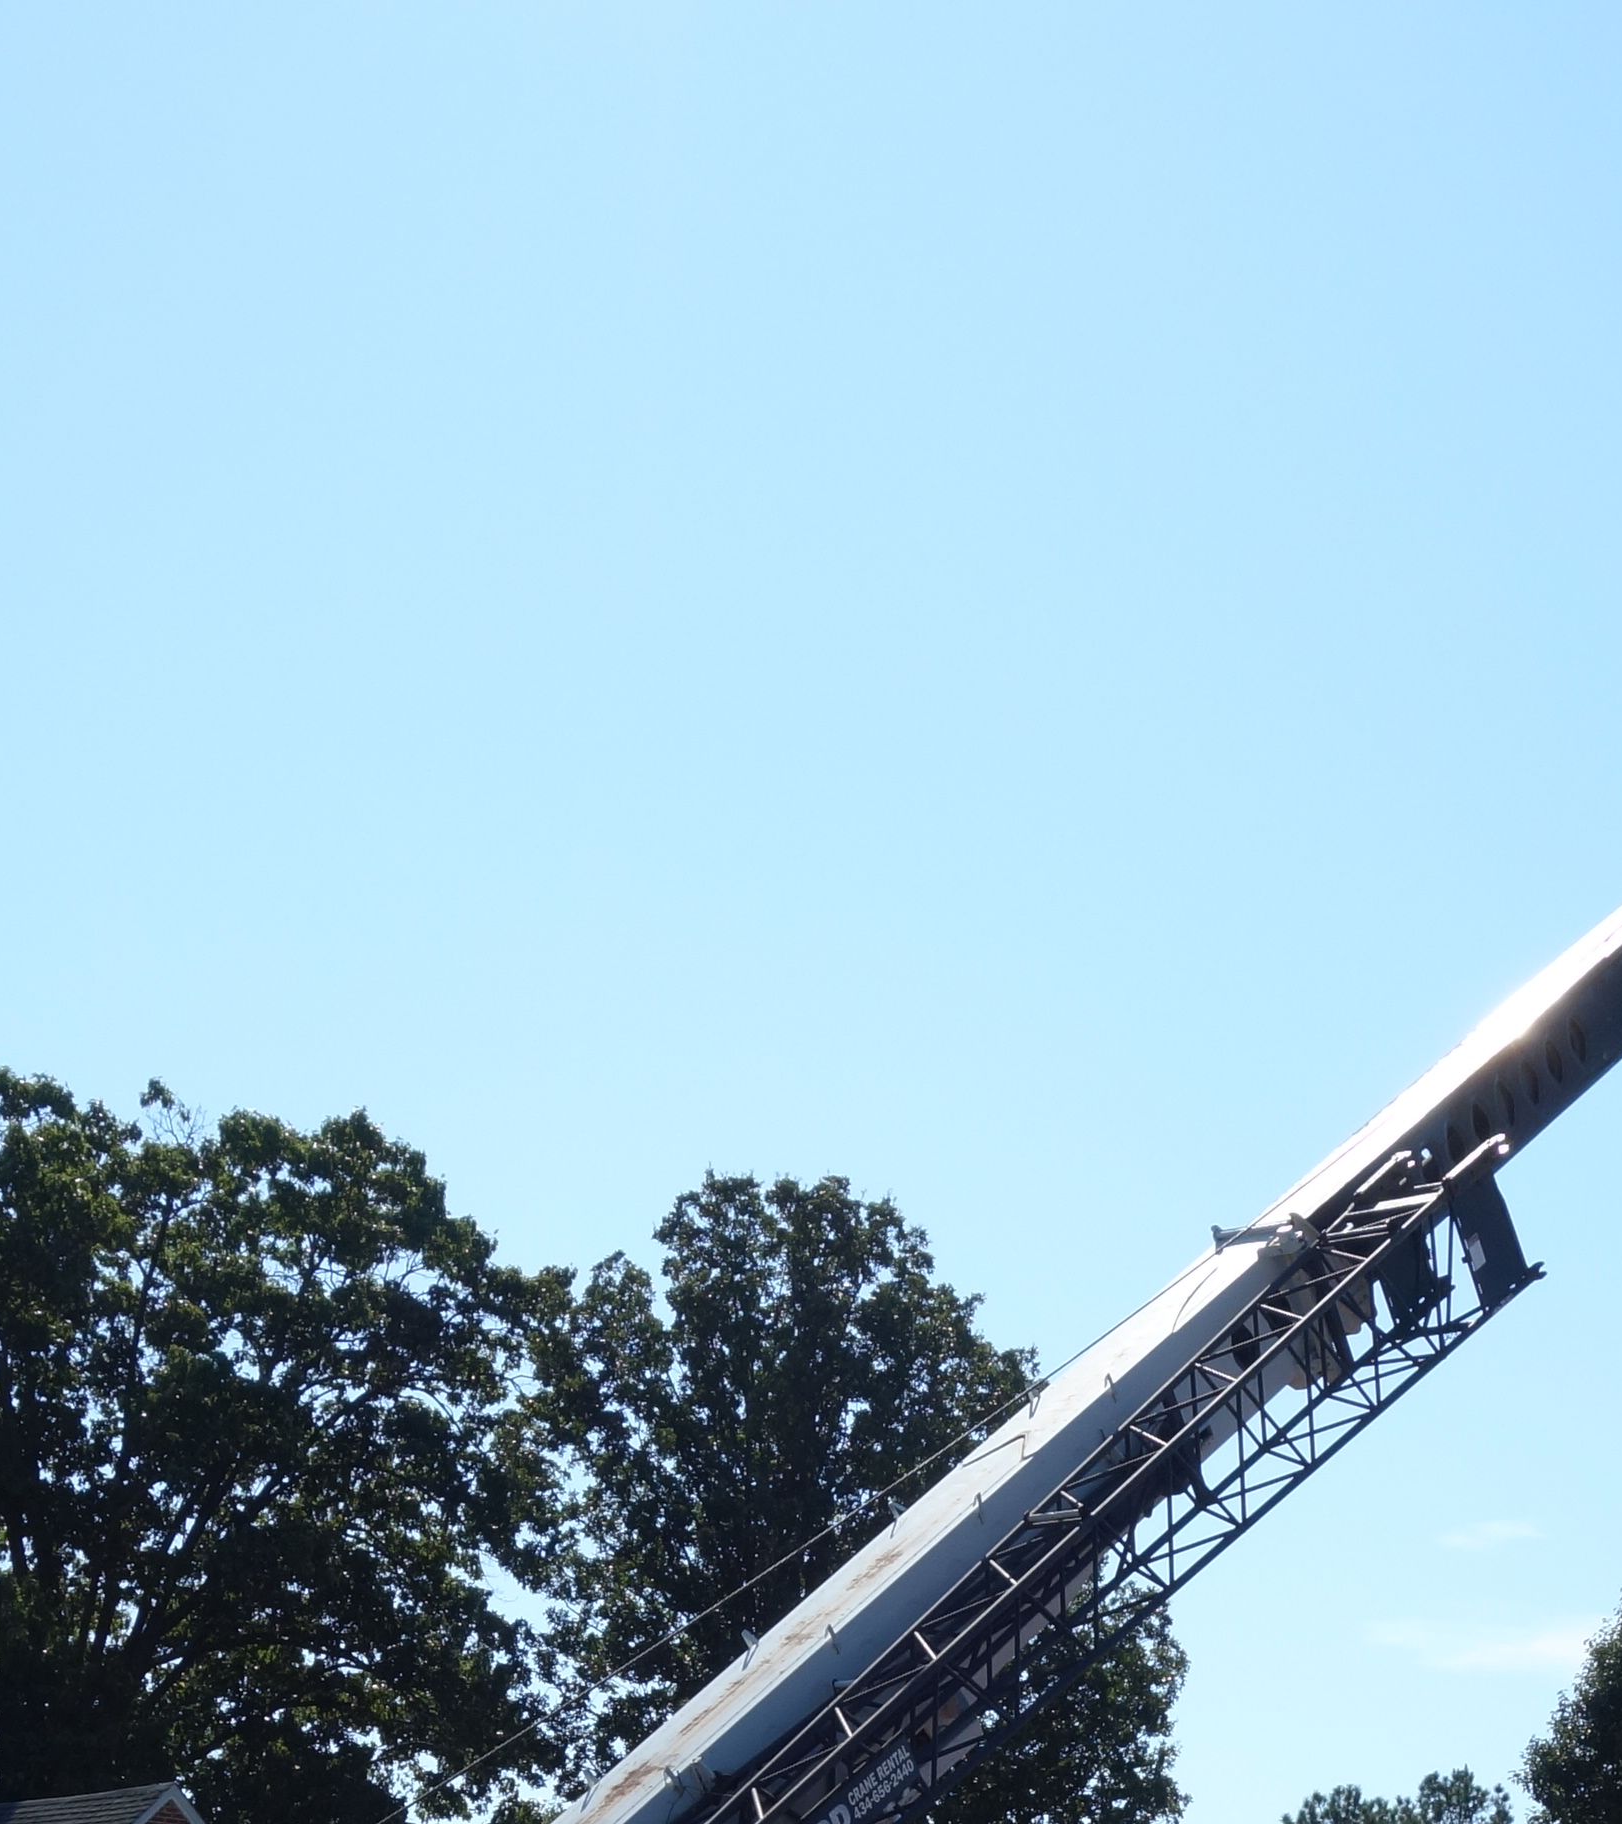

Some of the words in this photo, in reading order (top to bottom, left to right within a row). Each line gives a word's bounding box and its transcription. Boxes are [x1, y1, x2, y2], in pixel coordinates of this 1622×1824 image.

[847, 1771, 879, 1806] CRANE
[876, 1744, 911, 1780] RENTAL
[853, 1759, 915, 1819] 434-656-2440
